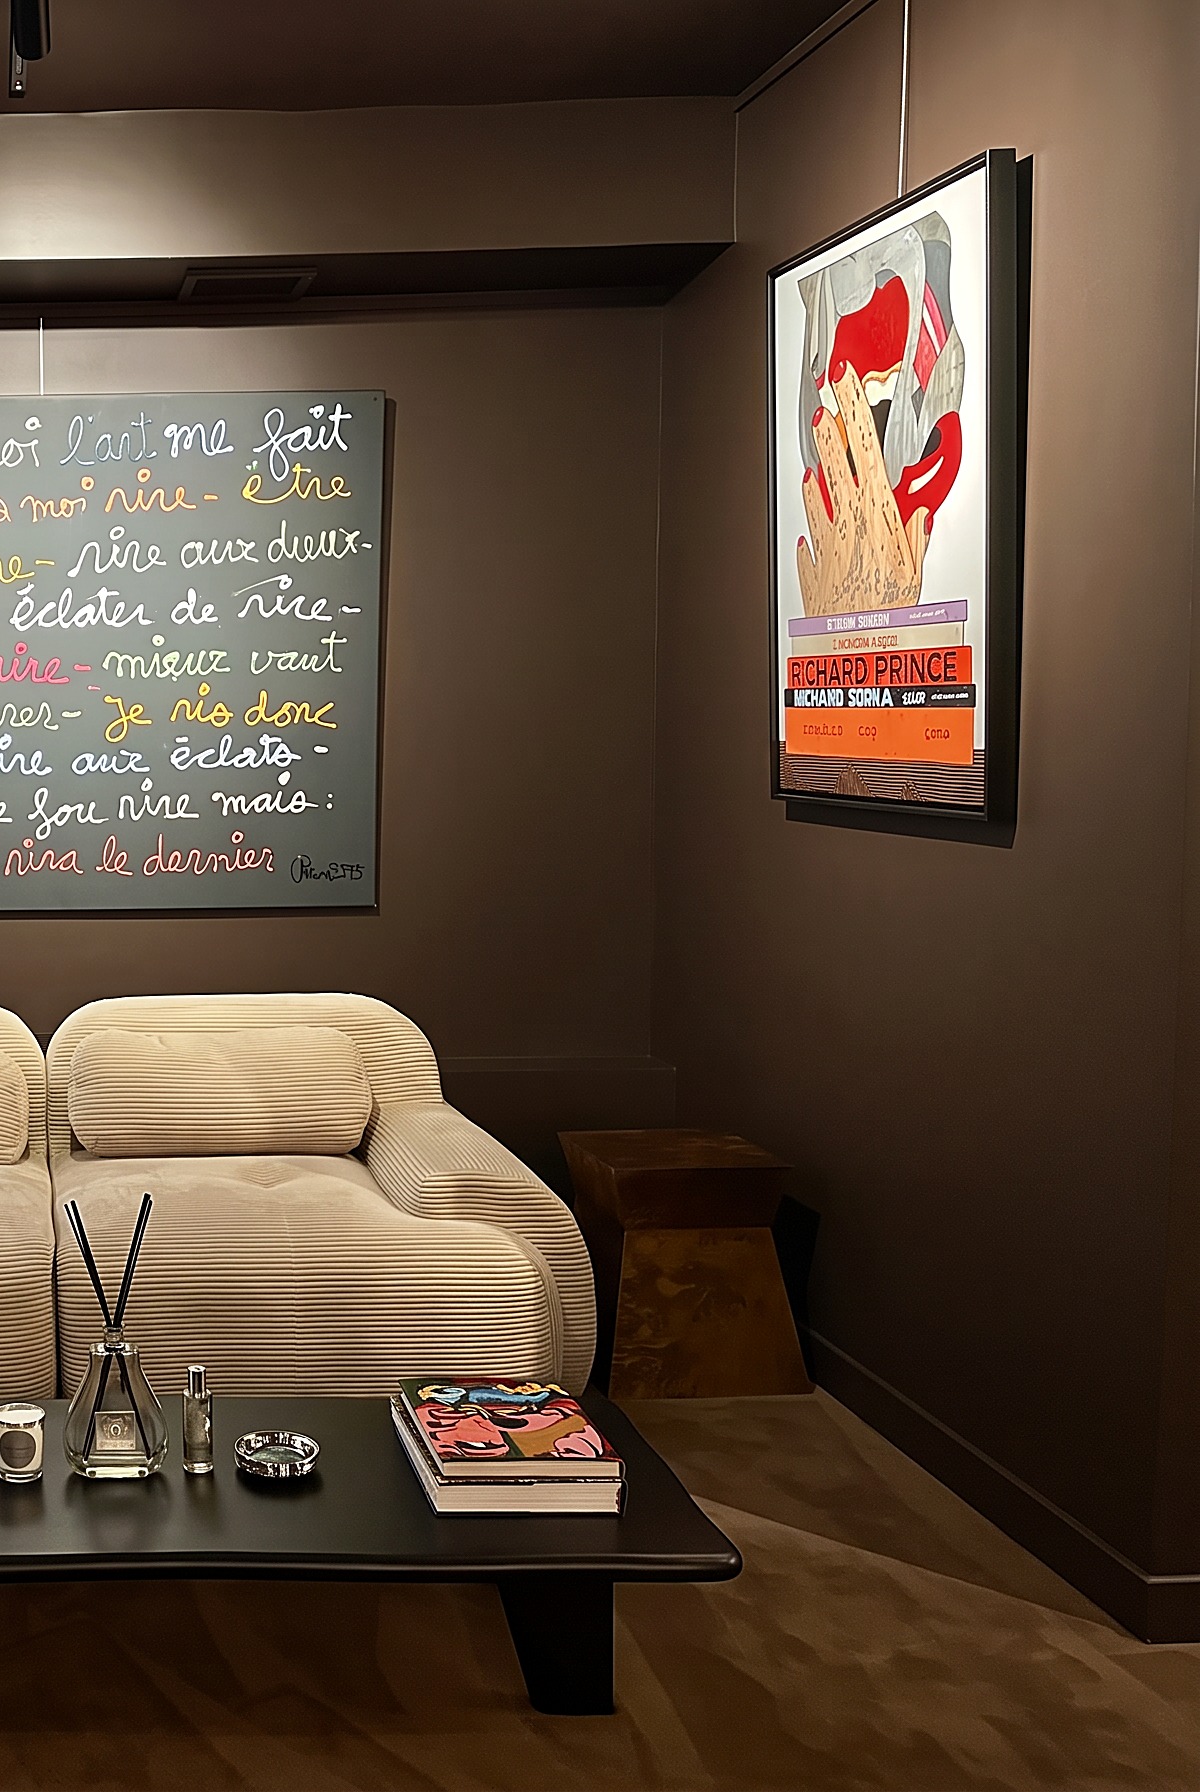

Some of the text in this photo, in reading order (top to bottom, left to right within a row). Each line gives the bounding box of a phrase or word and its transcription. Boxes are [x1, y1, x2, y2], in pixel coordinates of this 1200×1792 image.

[163, 419, 235, 458] me
[252, 402, 353, 482] fait
[19, 476, 94, 523] moi
[67, 525, 166, 578] rire
[180, 538, 260, 569] aux
[9, 582, 155, 632] éclater
[170, 588, 219, 625] de
[102, 635, 231, 682] mieux
[250, 631, 348, 674] vaut
[791, 651, 958, 686] RICHARD PRINCE
[169, 682, 234, 728] ris
[243, 690, 338, 730] donc
[71, 749, 151, 776] aux
[28, 787, 110, 840] fou
[118, 777, 200, 821] rire
[4, 837, 84, 877] rira
[95, 834, 134, 876] le
[142, 830, 275, 877] dernier
